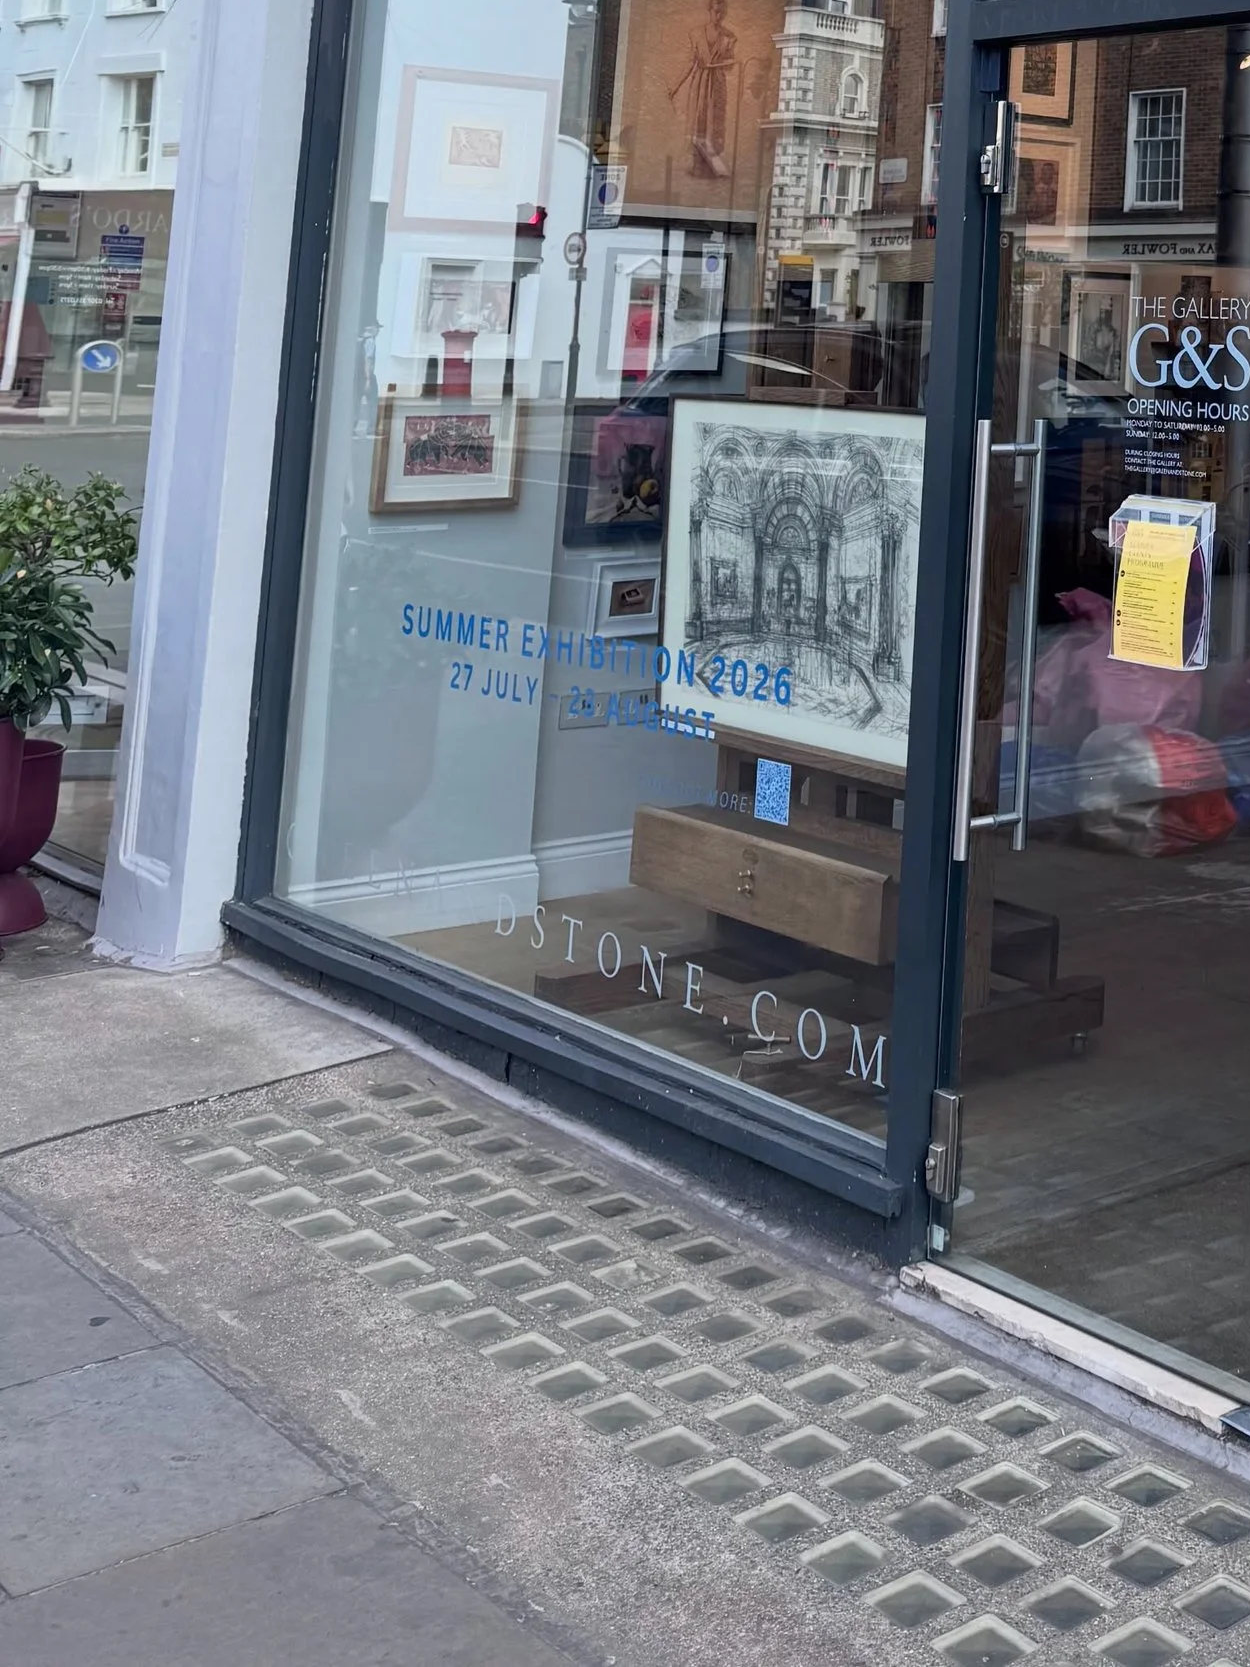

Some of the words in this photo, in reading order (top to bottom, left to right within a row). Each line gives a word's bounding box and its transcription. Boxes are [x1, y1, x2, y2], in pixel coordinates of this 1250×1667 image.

[1131, 296, 1167, 318] THE
[1127, 398, 1193, 418] OPENING
[1197, 401, 1250, 421] HOURS
[1126, 419, 1153, 428] MONDAY
[1154, 420, 1163, 429] TO
[1124, 449, 1143, 457] DURING
[1143, 450, 1164, 458] CLOSING
[1164, 451, 1180, 459] HOURS
[1124, 457, 1146, 465] CONTACT
[1147, 458, 1156, 466] THE
[1156, 459, 1176, 467] GALLERY
[402, 602, 509, 653] SUMMER
[521, 624, 695, 688] EXHIBITION
[709, 655, 792, 706] 2026
[450, 661, 474, 693] 27
[481, 668, 539, 706] JULY
[605, 691, 716, 742] AUGUST
